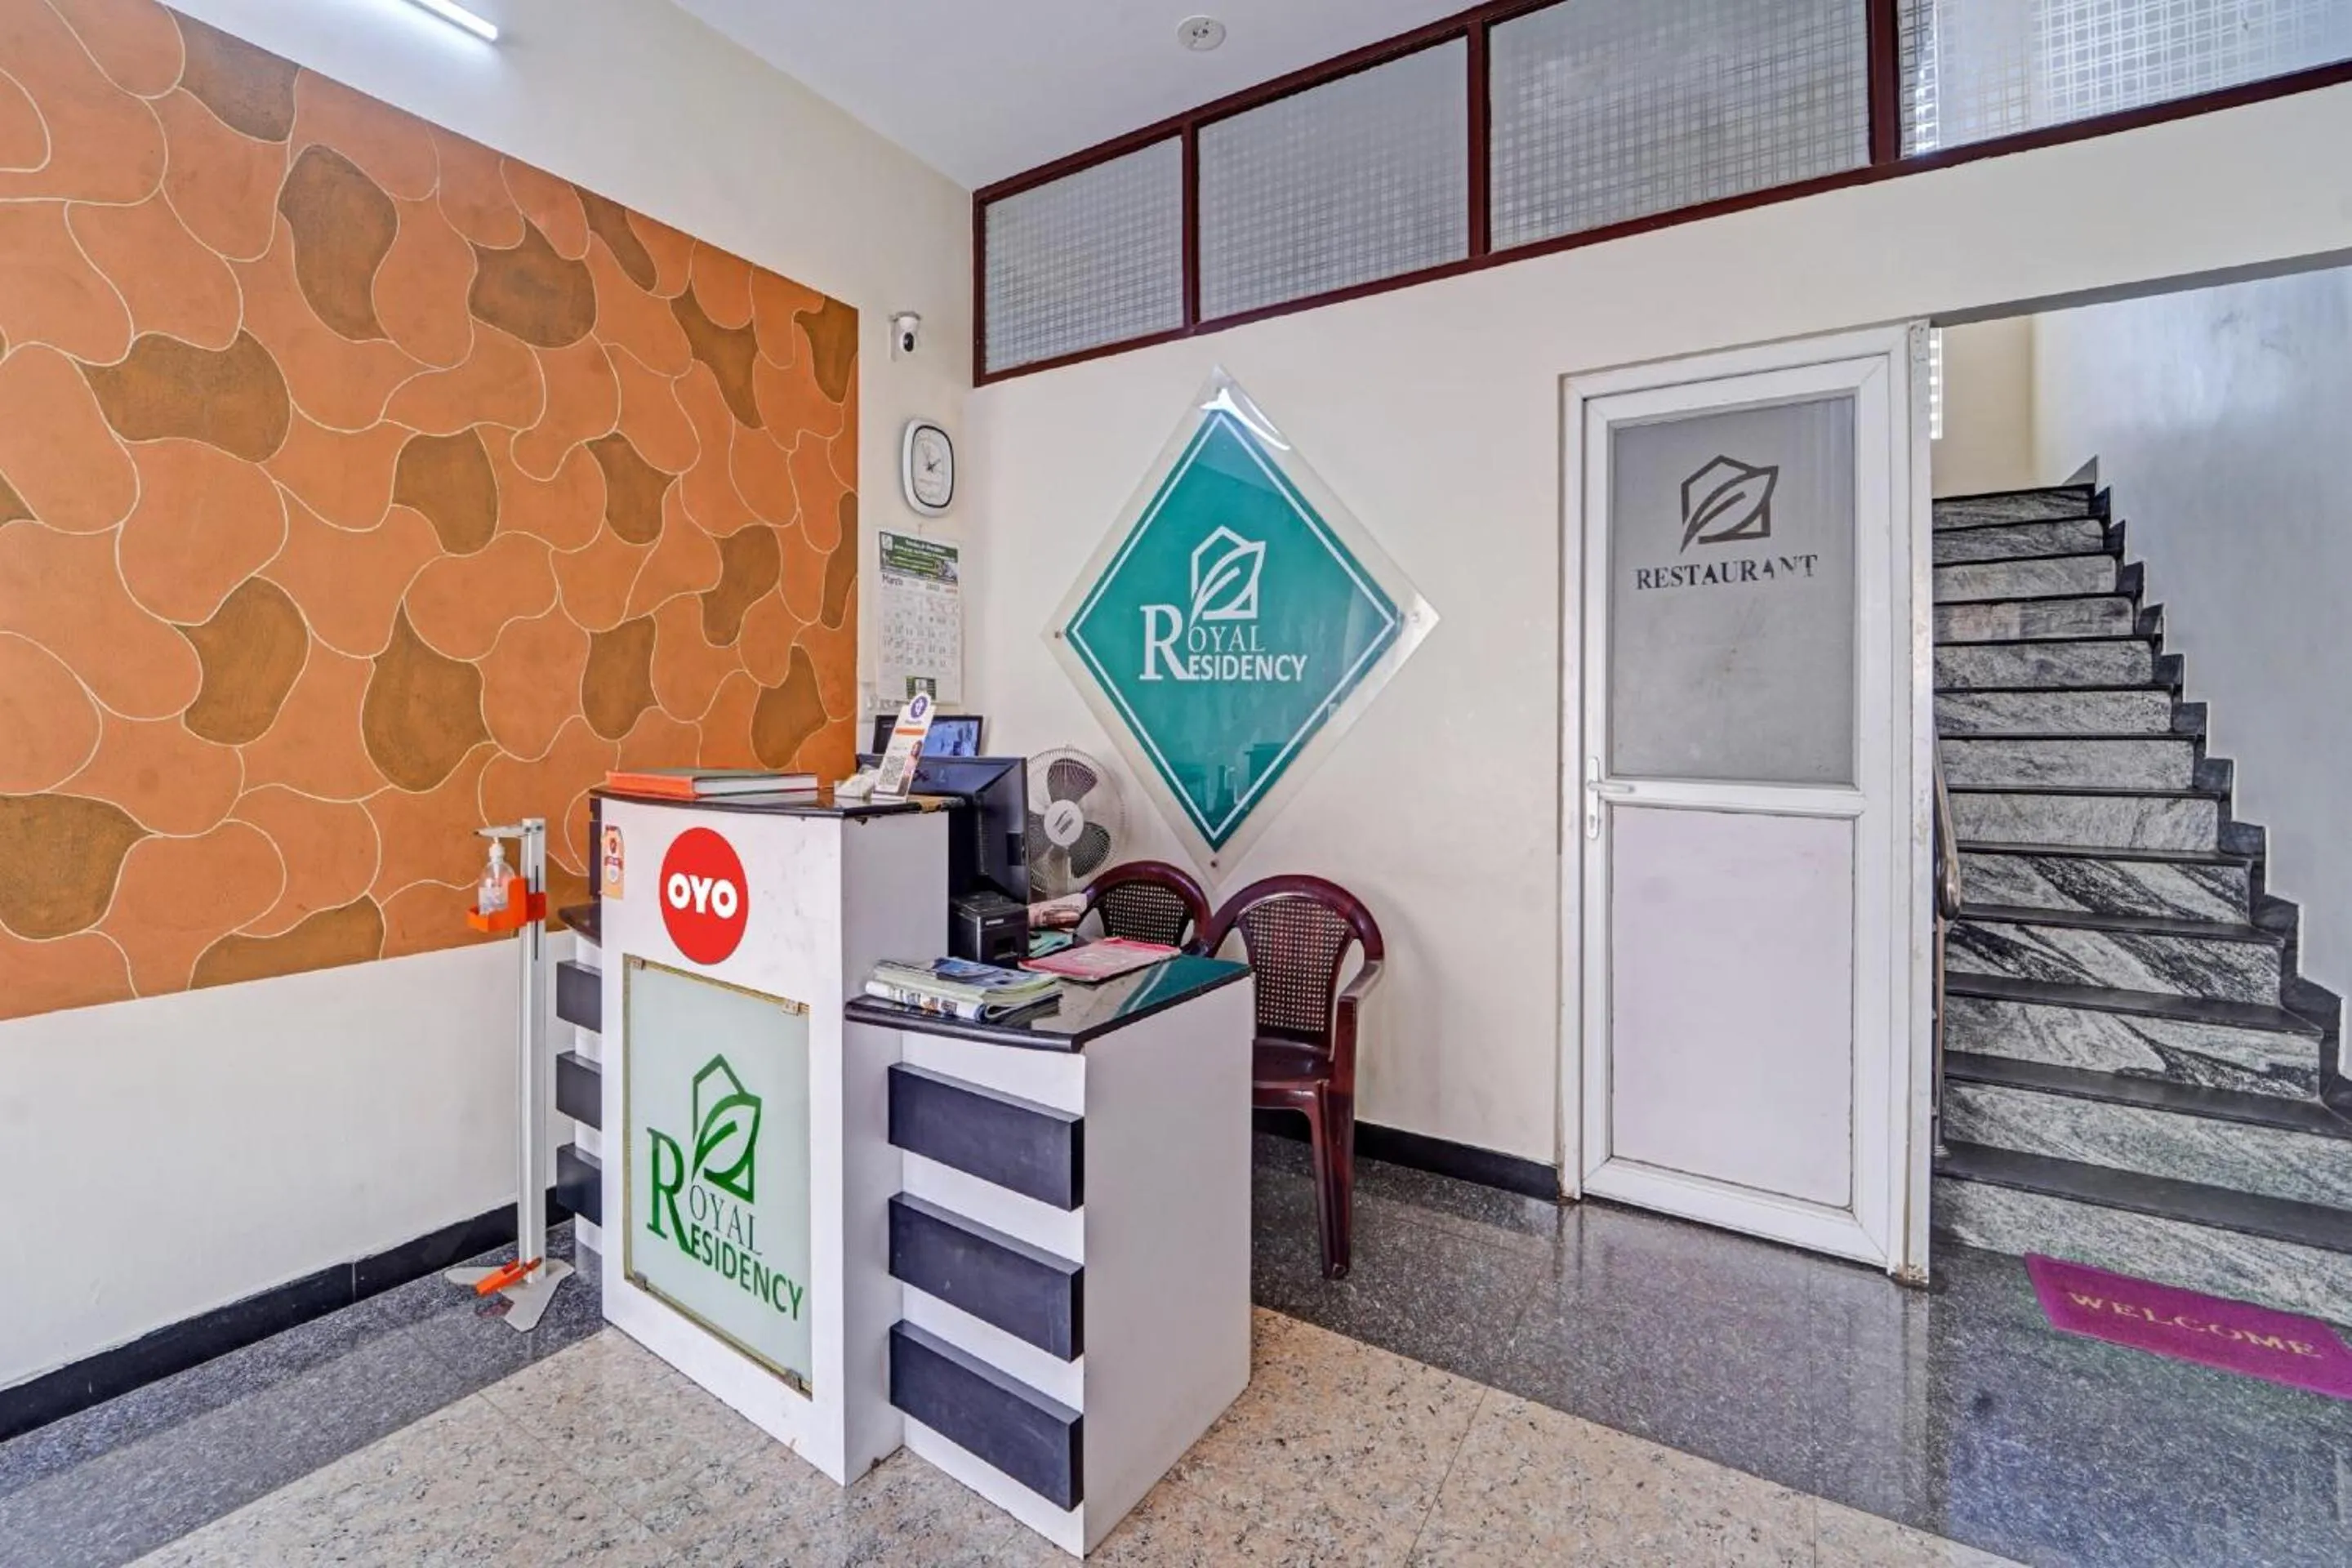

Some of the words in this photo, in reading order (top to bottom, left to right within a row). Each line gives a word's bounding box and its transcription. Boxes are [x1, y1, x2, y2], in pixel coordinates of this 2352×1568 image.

[1635, 555, 1818, 590] RESTAURANT
[667, 872, 737, 919] OYO
[2069, 1291, 2323, 1358] WELCOME
